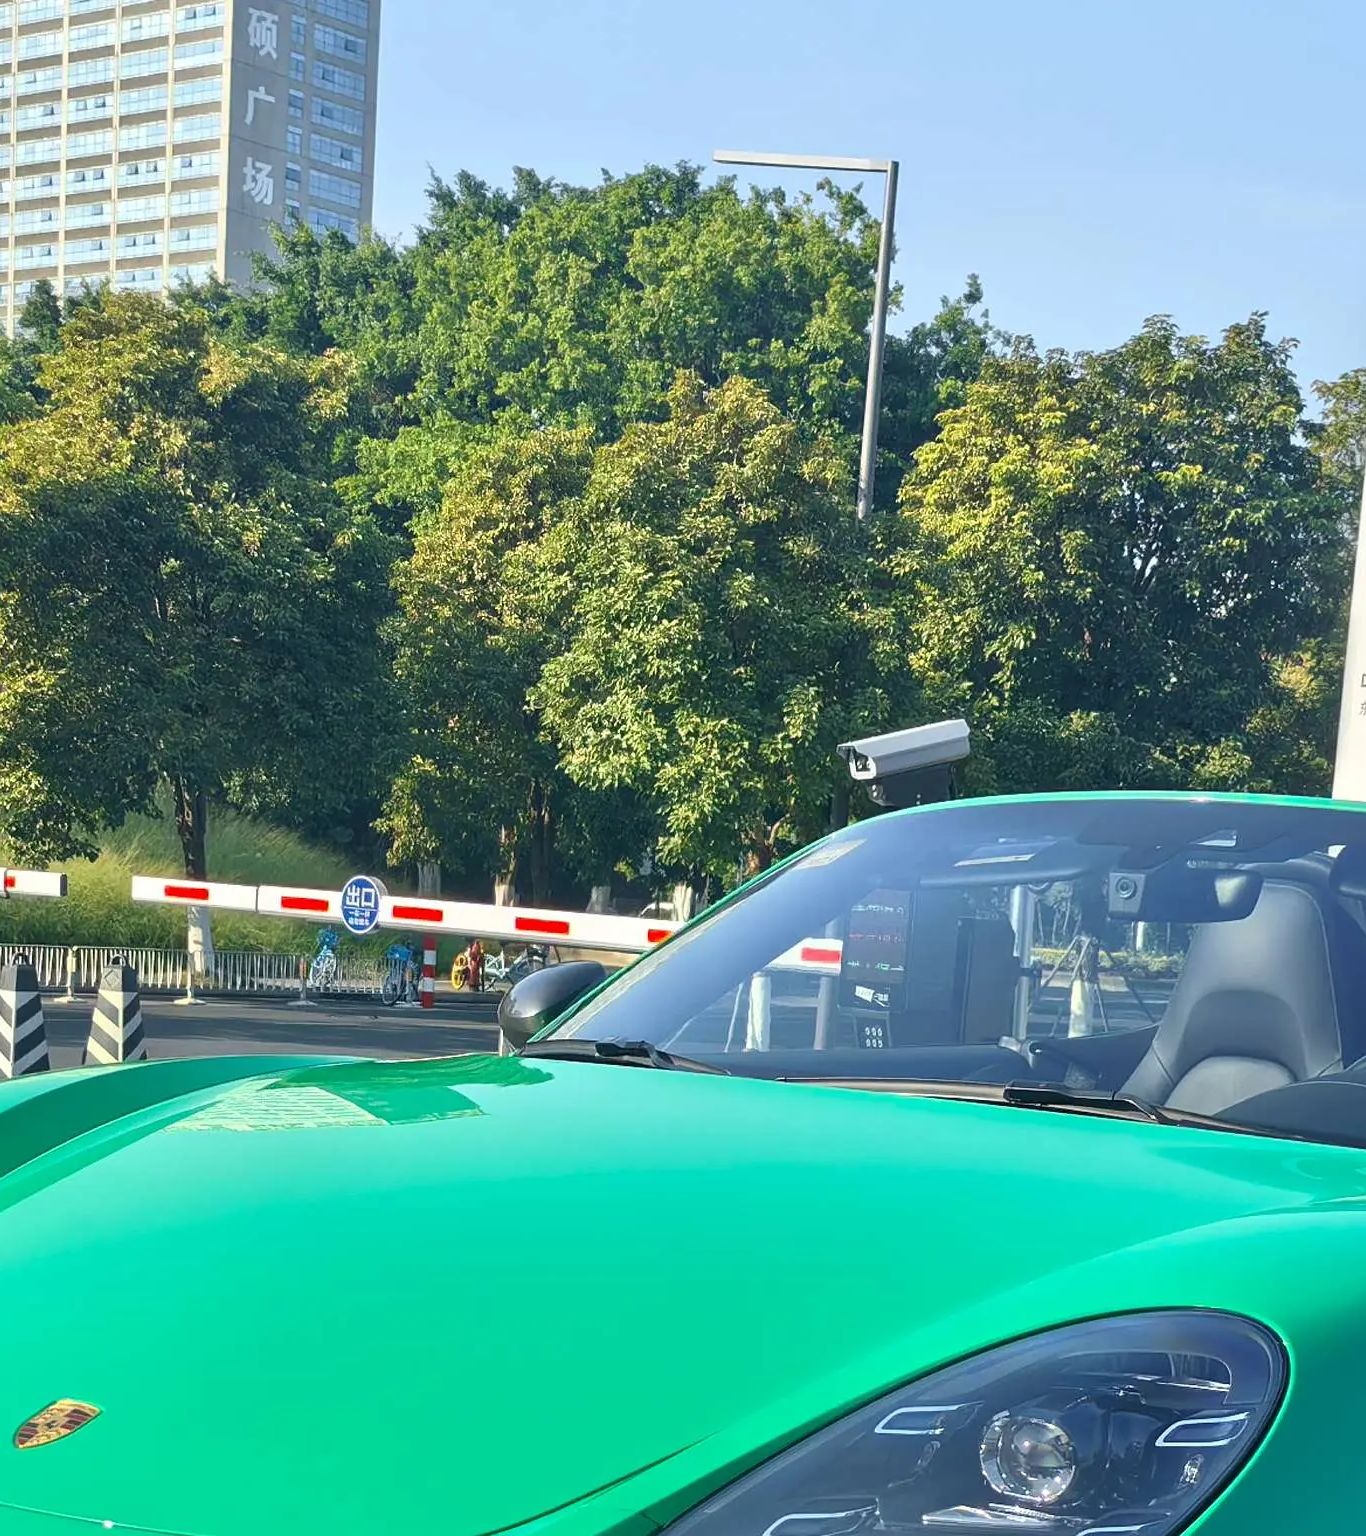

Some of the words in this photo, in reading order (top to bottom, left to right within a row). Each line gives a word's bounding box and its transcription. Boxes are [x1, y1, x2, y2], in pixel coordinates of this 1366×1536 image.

[242, 7, 279, 206] 硕广场
[346, 884, 375, 908] 出口
